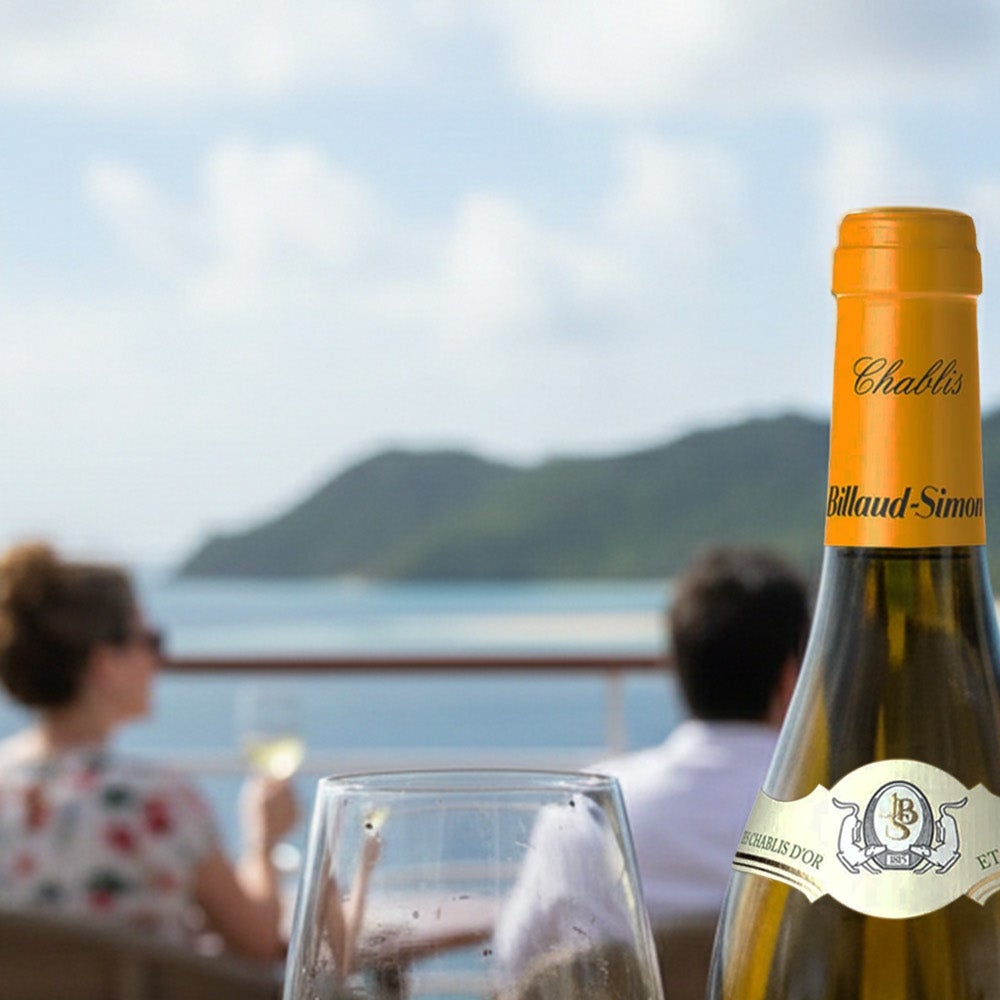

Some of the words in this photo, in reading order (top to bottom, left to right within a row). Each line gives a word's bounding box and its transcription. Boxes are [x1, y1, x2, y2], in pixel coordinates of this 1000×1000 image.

[853, 356, 964, 396] Chablis
[827, 485, 983, 519] Billaud-Simon
[749, 832, 790, 856] CHABLIS
[789, 844, 824, 870] D'OR
[976, 849, 999, 870] ET
